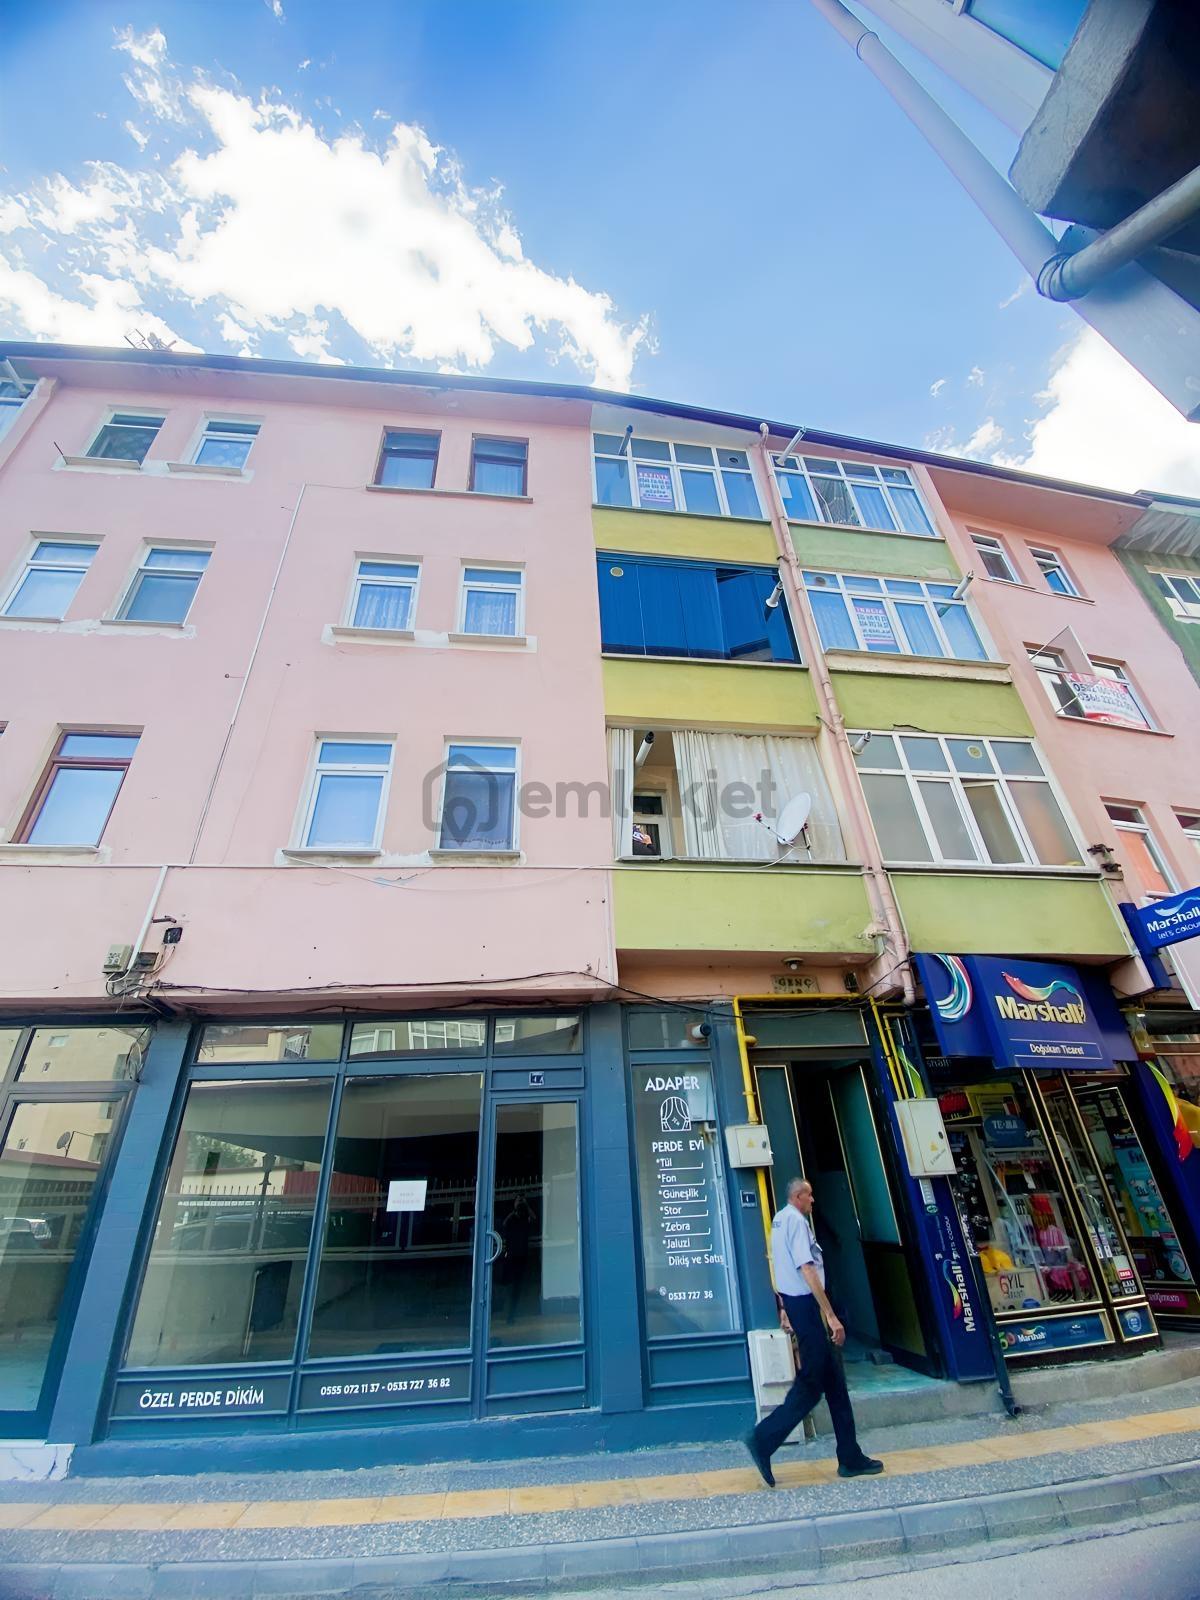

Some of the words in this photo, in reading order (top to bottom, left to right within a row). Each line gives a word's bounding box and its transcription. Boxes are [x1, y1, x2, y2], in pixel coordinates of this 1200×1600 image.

[1147, 906, 1200, 933] Marshall
[994, 995, 1085, 1024] Marshall
[1029, 1043, 1061, 1056] Doğukan
[1061, 1044, 1084, 1055] Ticaret
[645, 1075, 700, 1092] ADAPER
[652, 1140, 684, 1153] PERDE
[689, 1137, 705, 1151] EVİ
[661, 1173, 677, 1183] Fon
[662, 1188, 699, 1200] Güneşlik
[664, 1205, 682, 1215] Stor
[665, 1221, 691, 1231] Zebra
[668, 1255, 690, 1268] Dikiş
[691, 1256, 702, 1264] ve
[668, 1291, 686, 1301] 0533
[687, 1290, 701, 1300] 727
[704, 1290, 713, 1299] 36
[951, 1264, 977, 1333] Marshall
[320, 1385, 342, 1396] 0555
[343, 1384, 359, 1394] 072
[361, 1384, 368, 1393] 11
[370, 1383, 380, 1393] 37
[387, 1381, 408, 1392] 0533
[409, 1380, 424, 1390] 727
[427, 1378, 438, 1389] 36
[439, 1377, 451, 1388] 82
[139, 1388, 175, 1408] ÖZEL
[178, 1391, 222, 1408] PERDE
[225, 1385, 264, 1405] DİKİM
